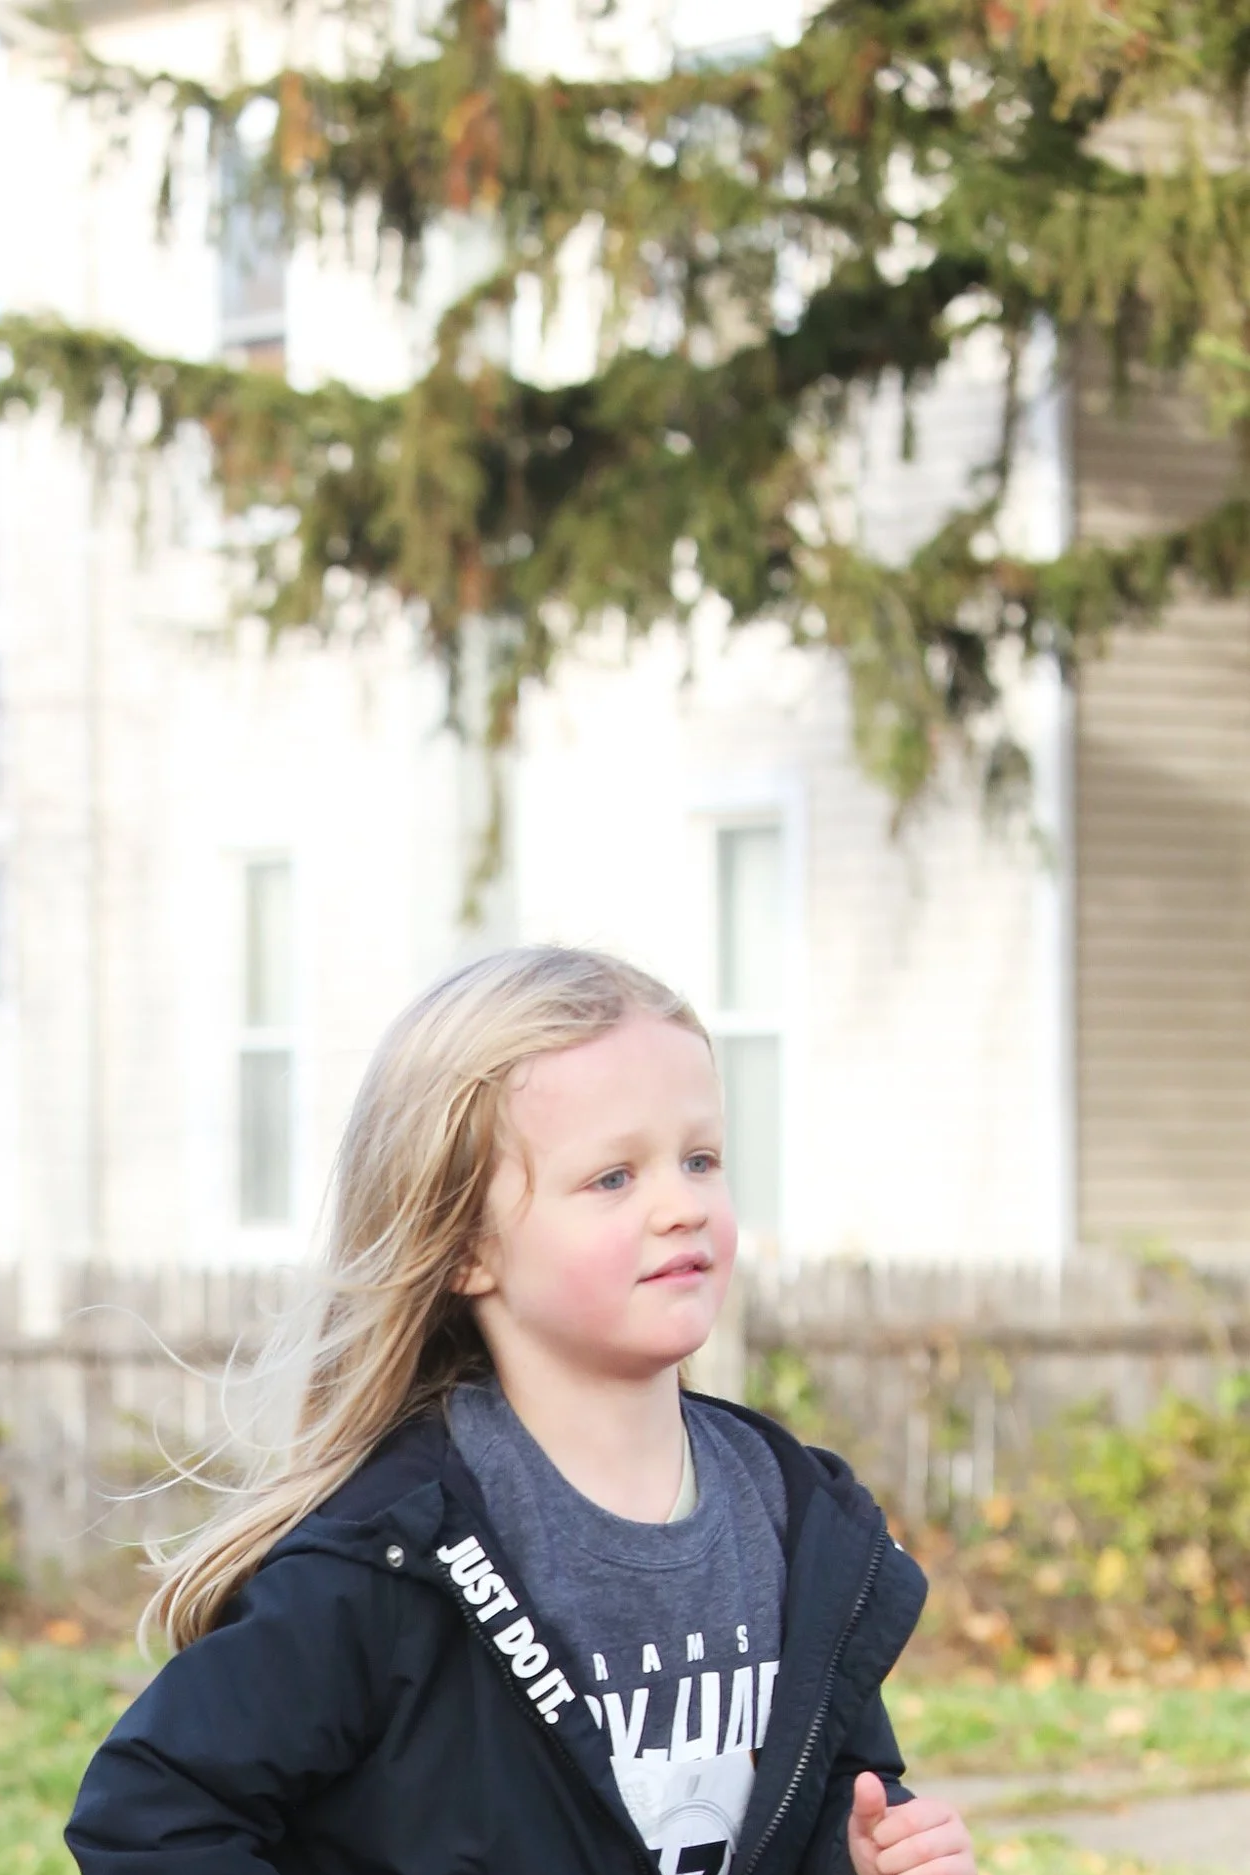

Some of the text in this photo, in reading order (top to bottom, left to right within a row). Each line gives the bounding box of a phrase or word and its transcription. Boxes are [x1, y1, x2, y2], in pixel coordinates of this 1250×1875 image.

[436, 1535, 576, 1724] JUST DO IT.
[592, 1624, 749, 1681] RAMS
